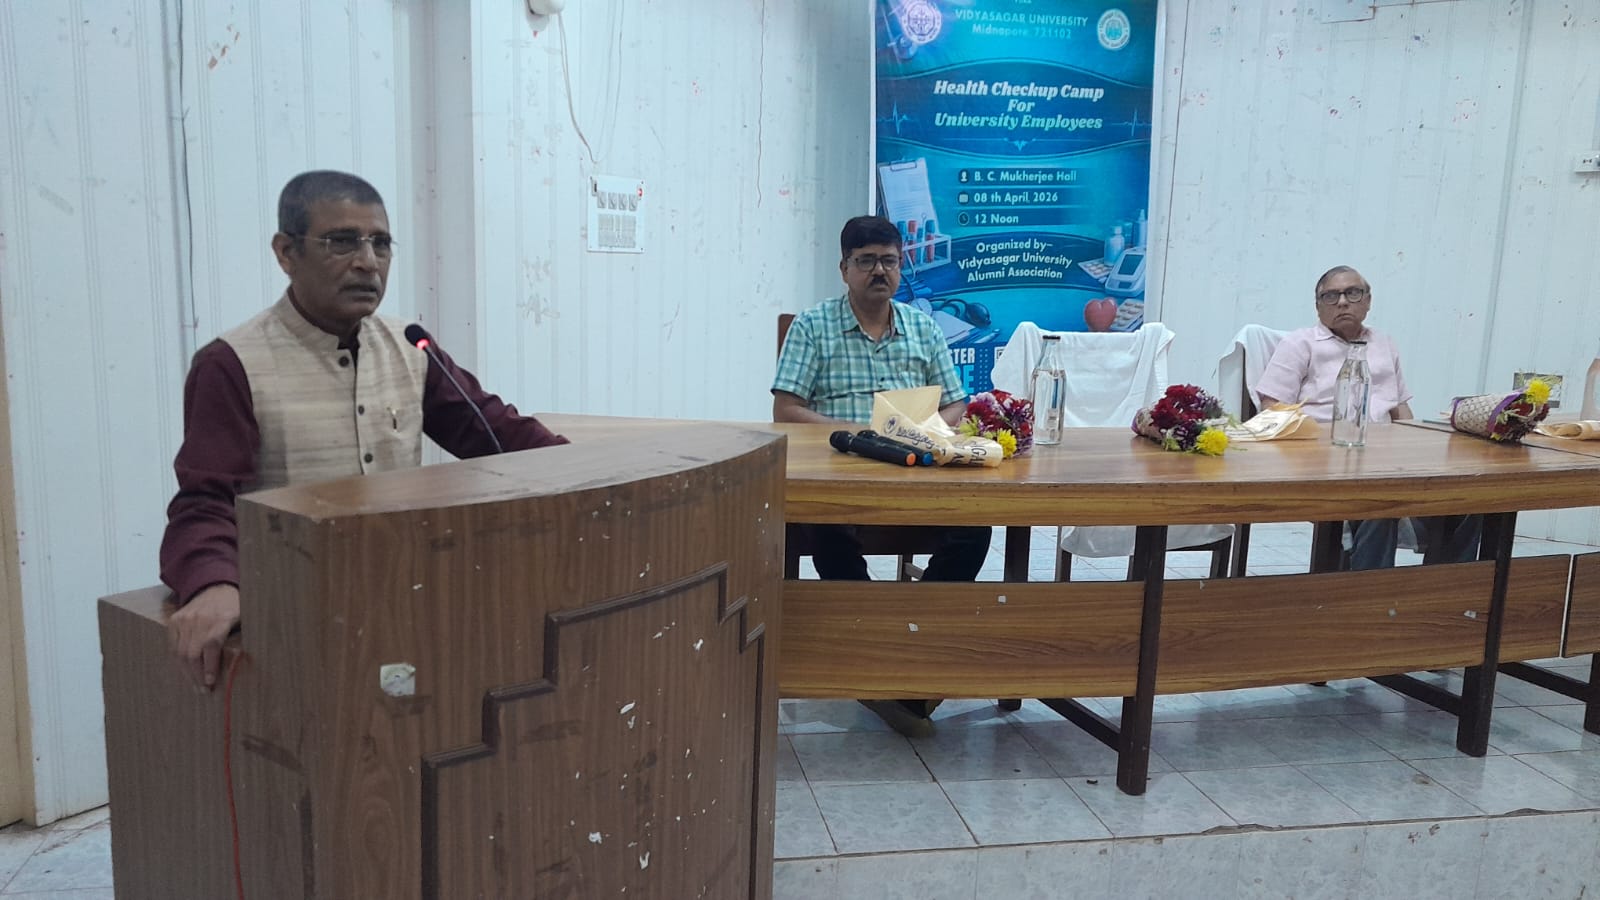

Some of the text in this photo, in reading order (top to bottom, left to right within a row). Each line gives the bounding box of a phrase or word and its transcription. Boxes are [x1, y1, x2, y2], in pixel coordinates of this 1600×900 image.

[955, 9, 1089, 27] VIDYASAGAR UNIVERSITY
[933, 80, 1104, 102] Health Checkup Camp
[1007, 99, 1035, 112] For
[934, 112, 1103, 131] University Employees
[974, 171, 984, 181] B.
[1000, 170, 1054, 184] Mukherjee
[1056, 170, 1077, 181] Hall
[974, 192, 988, 203] 08
[991, 191, 1002, 203] th
[1033, 192, 1058, 202] 2026
[975, 213, 1019, 224] 12 Noon
[976, 238, 1031, 253] Organized
[957, 252, 1073, 270] Vidyasagar University
[967, 266, 1063, 283] Alumni Association
